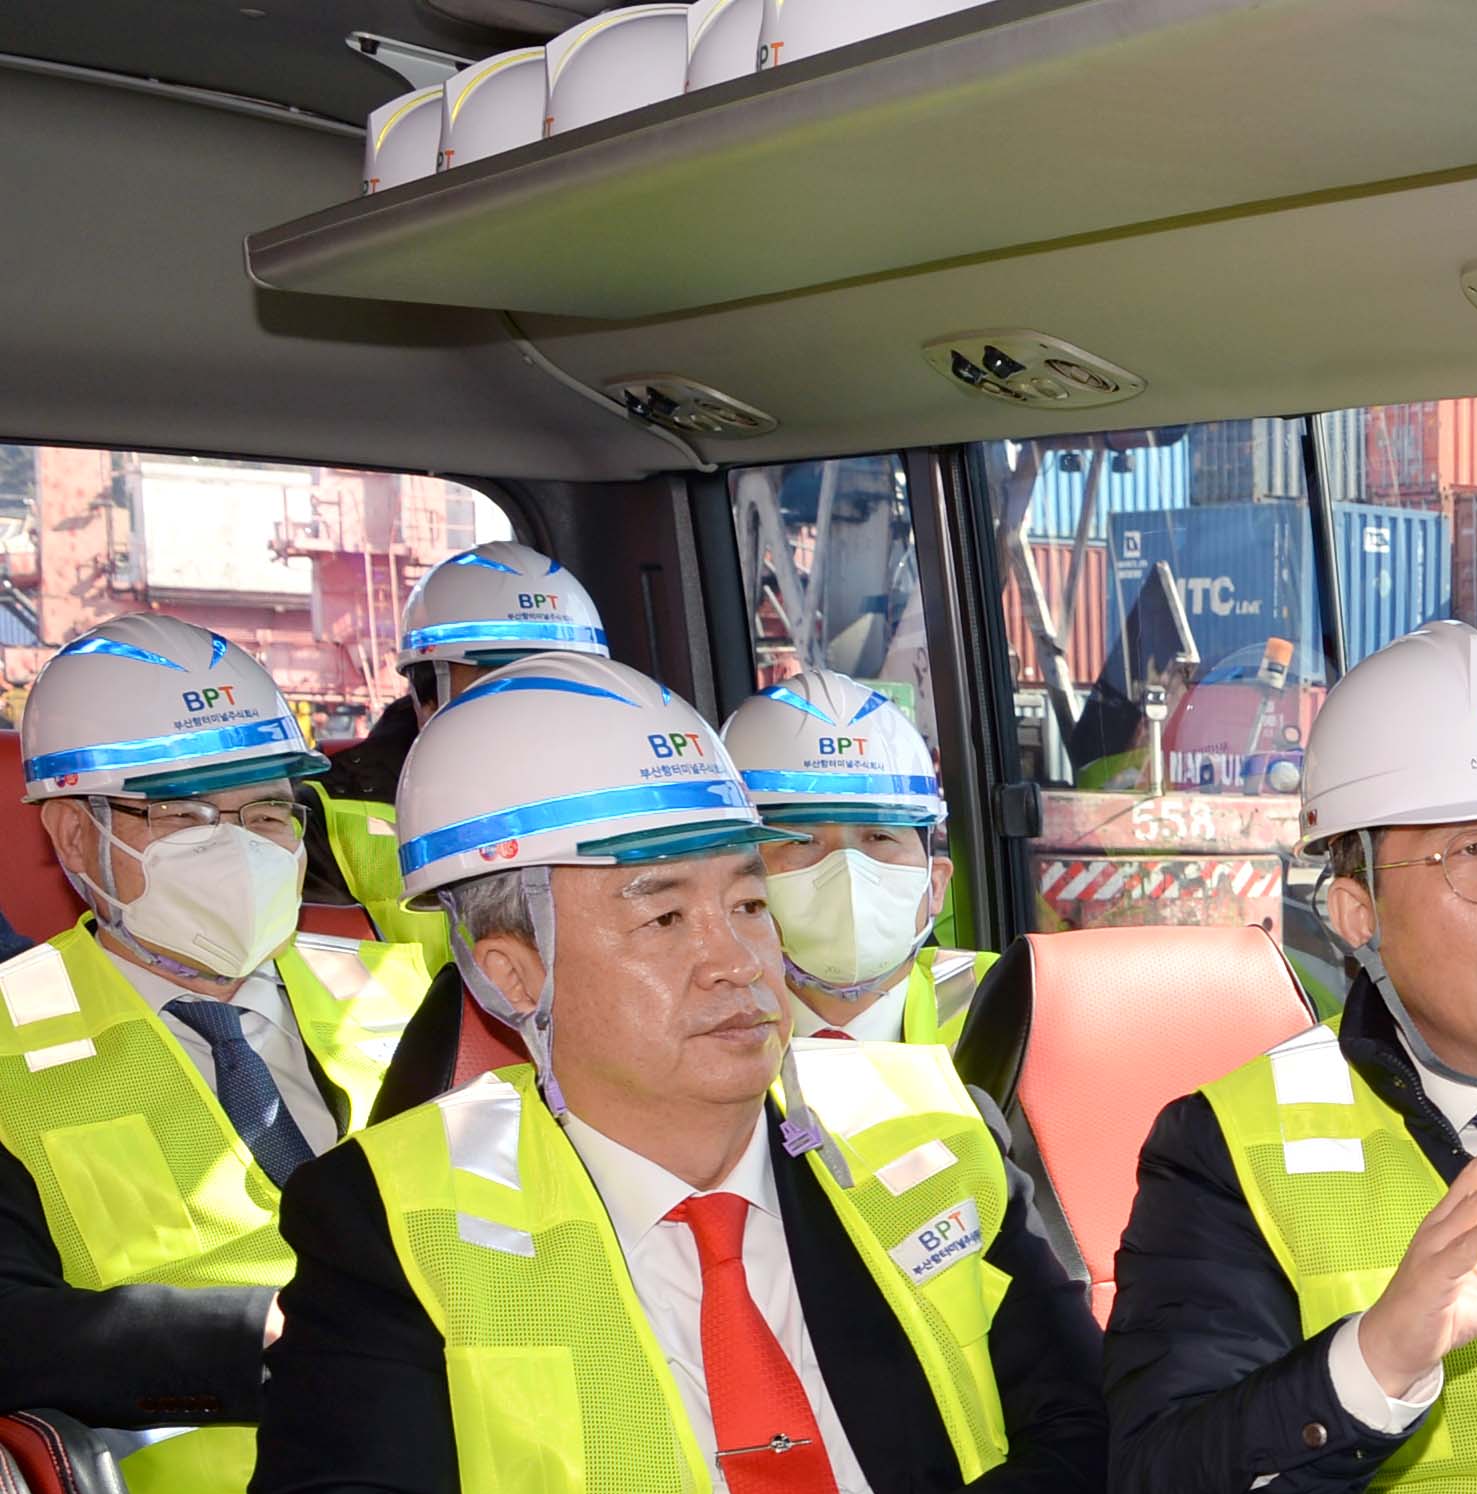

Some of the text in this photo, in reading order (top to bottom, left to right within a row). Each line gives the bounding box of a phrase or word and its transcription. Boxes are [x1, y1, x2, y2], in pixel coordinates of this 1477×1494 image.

[517, 593, 559, 610] BPT
[1176, 575, 1236, 617] TC
[182, 685, 236, 713] BPT
[647, 732, 704, 758] BPT
[818, 737, 868, 755] BPT
[1130, 799, 1216, 841] 558
[918, 1210, 966, 1251] BPT
